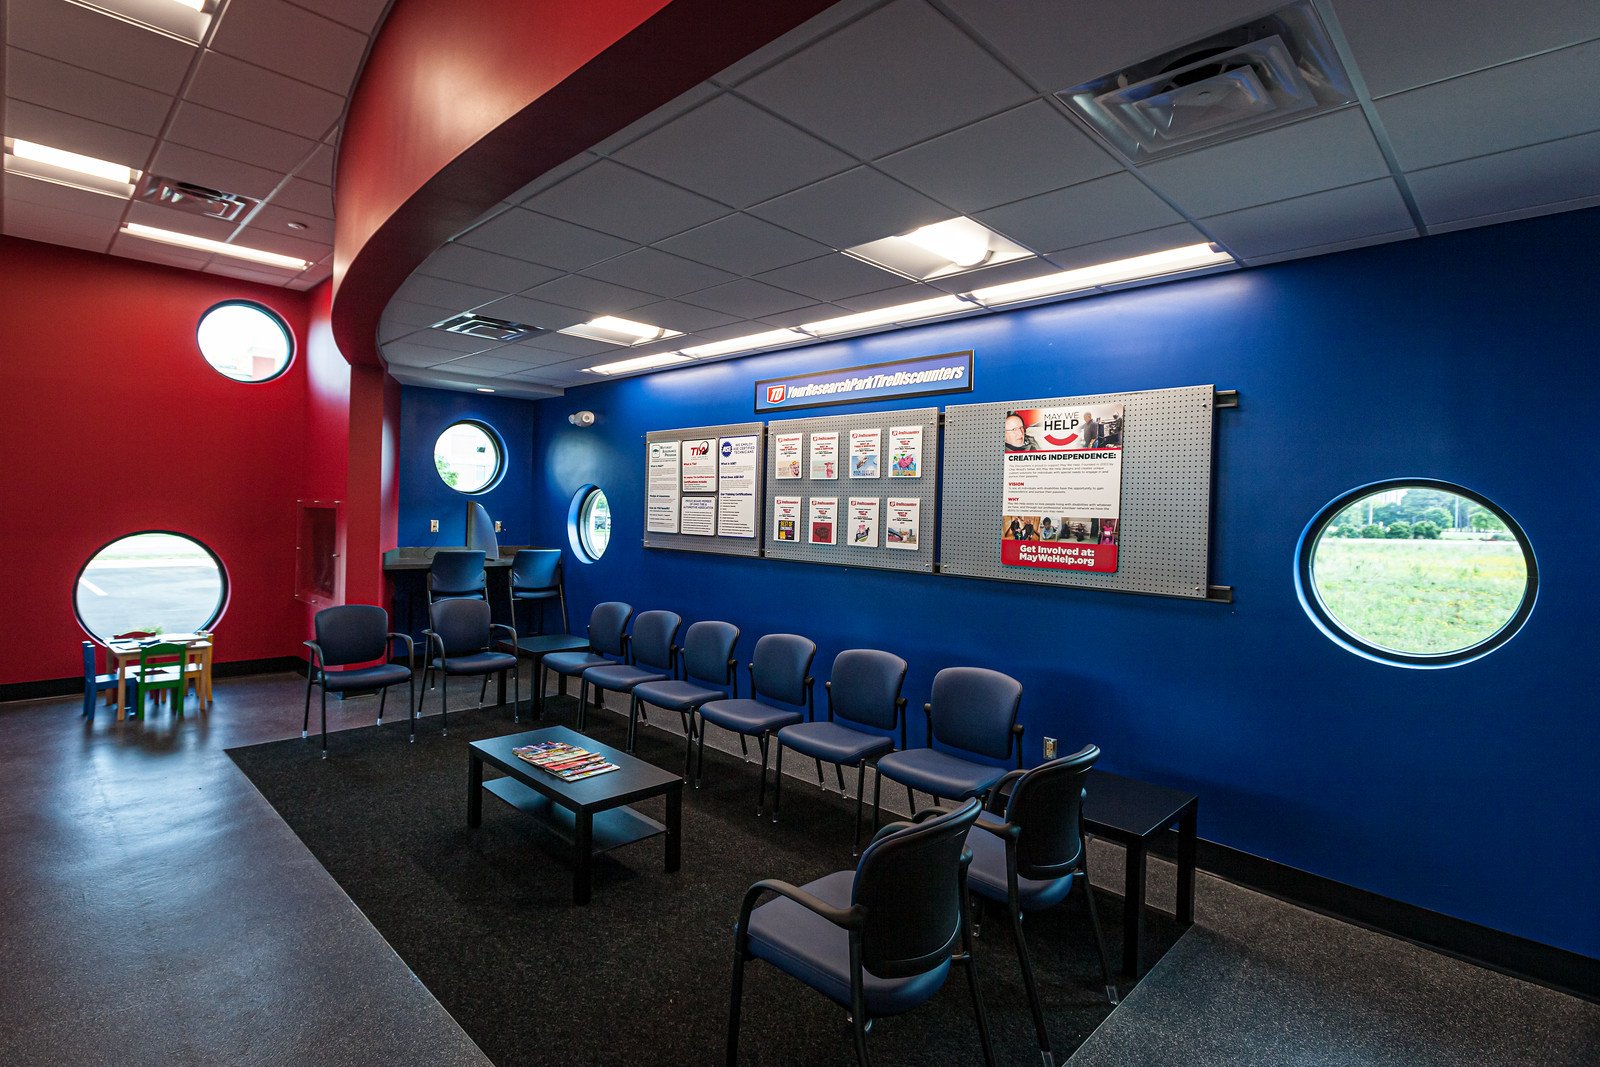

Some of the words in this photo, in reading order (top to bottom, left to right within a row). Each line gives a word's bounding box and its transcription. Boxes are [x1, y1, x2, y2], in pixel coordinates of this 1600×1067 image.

[769, 388, 785, 402] TD
[1044, 419, 1079, 431] HELP
[1048, 452, 1116, 460] INDEPENDENCE:
[1038, 546, 1079, 556] Involved
[1019, 552, 1095, 566] MayWeHelp.org
